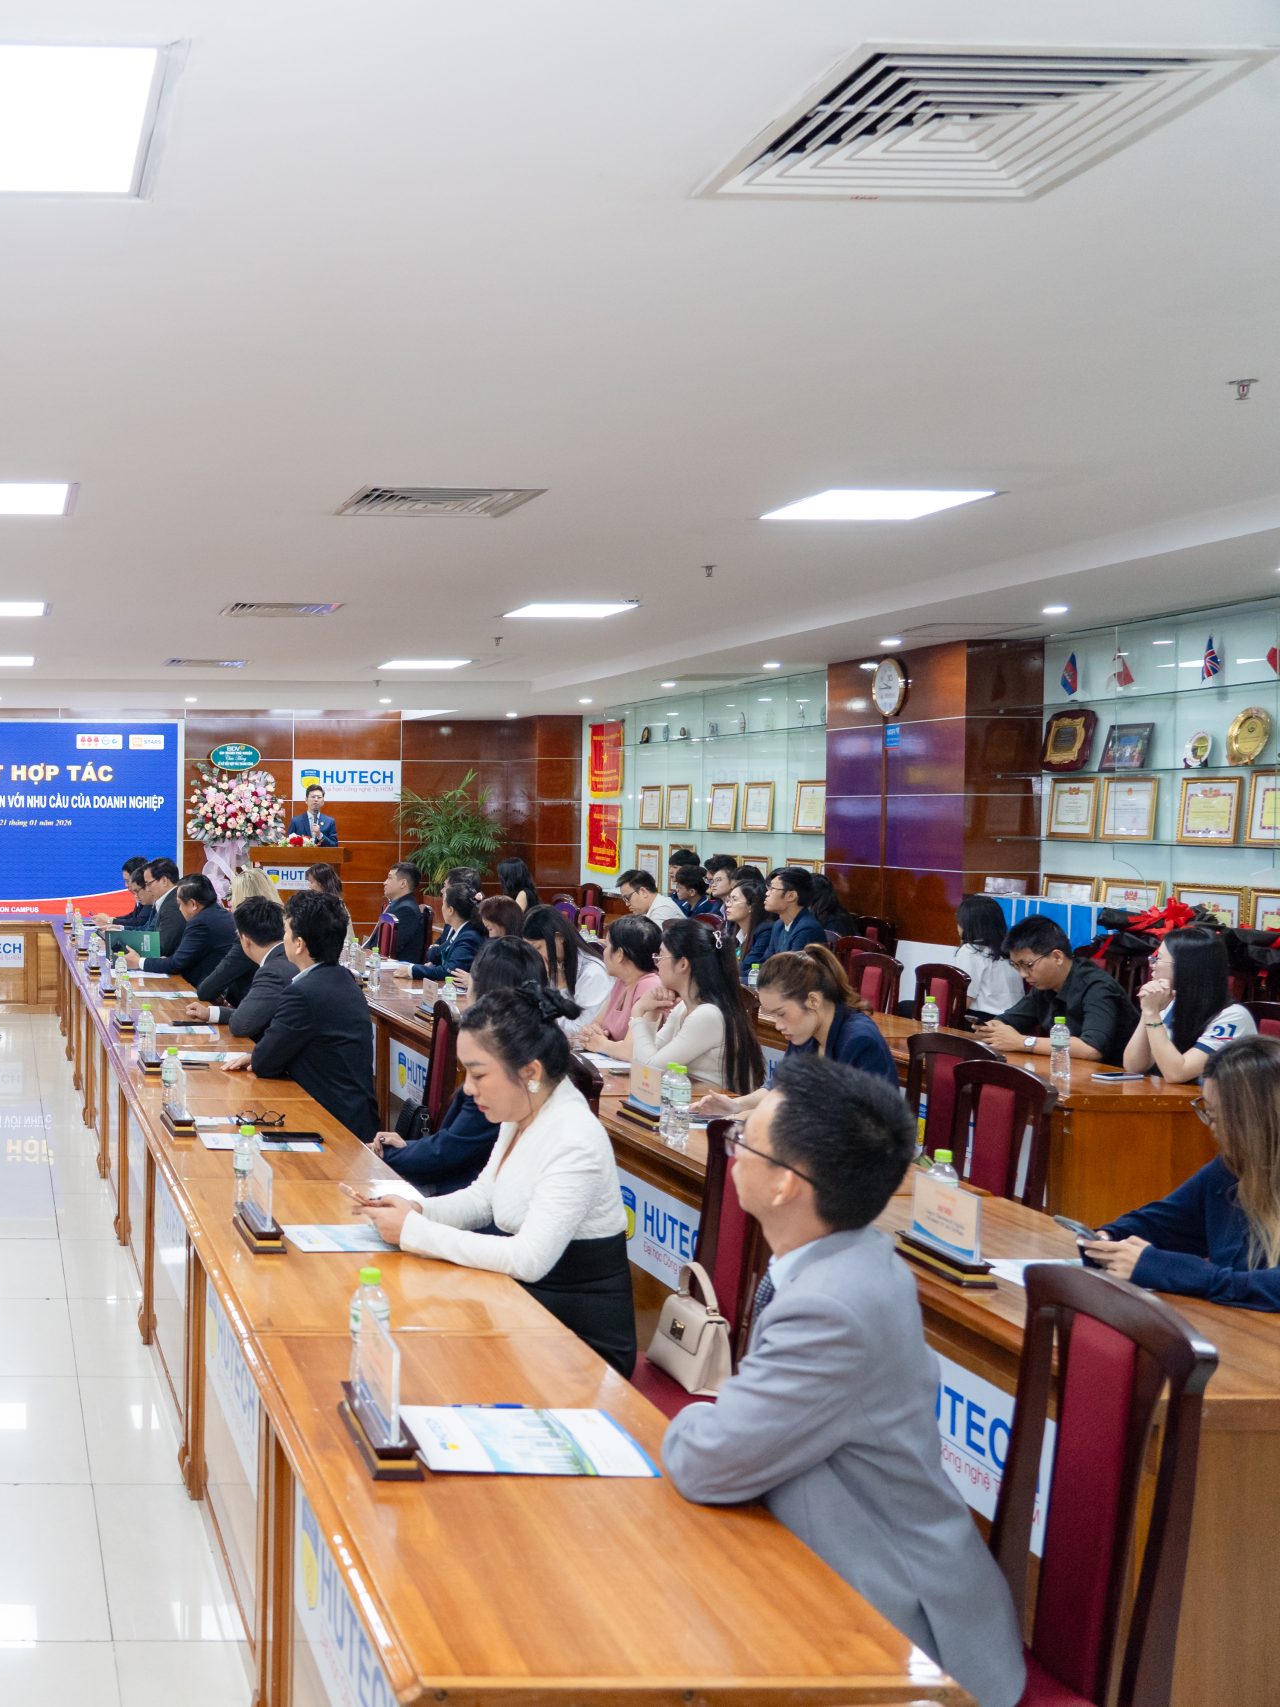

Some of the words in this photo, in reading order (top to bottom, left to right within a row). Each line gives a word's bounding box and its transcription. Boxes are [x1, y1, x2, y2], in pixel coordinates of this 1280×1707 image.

[10, 762, 60, 785] HỢP
[66, 761, 114, 782] TÁC
[323, 770, 394, 784] HUTECH
[8, 791, 25, 808] VỚI
[27, 795, 47, 809] NHU
[71, 792, 92, 809] CỦA
[93, 795, 127, 809] DOANH
[128, 794, 165, 812] NGHIỆP
[281, 870, 308, 880] HUT
[1211, 1023, 1237, 1038] 21
[407, 1058, 426, 1090] HUTE
[644, 1201, 699, 1259] HUTEC
[936, 1381, 1012, 1471] TEC
[941, 1444, 962, 1473] ông
[321, 1540, 397, 1707] HUTE
